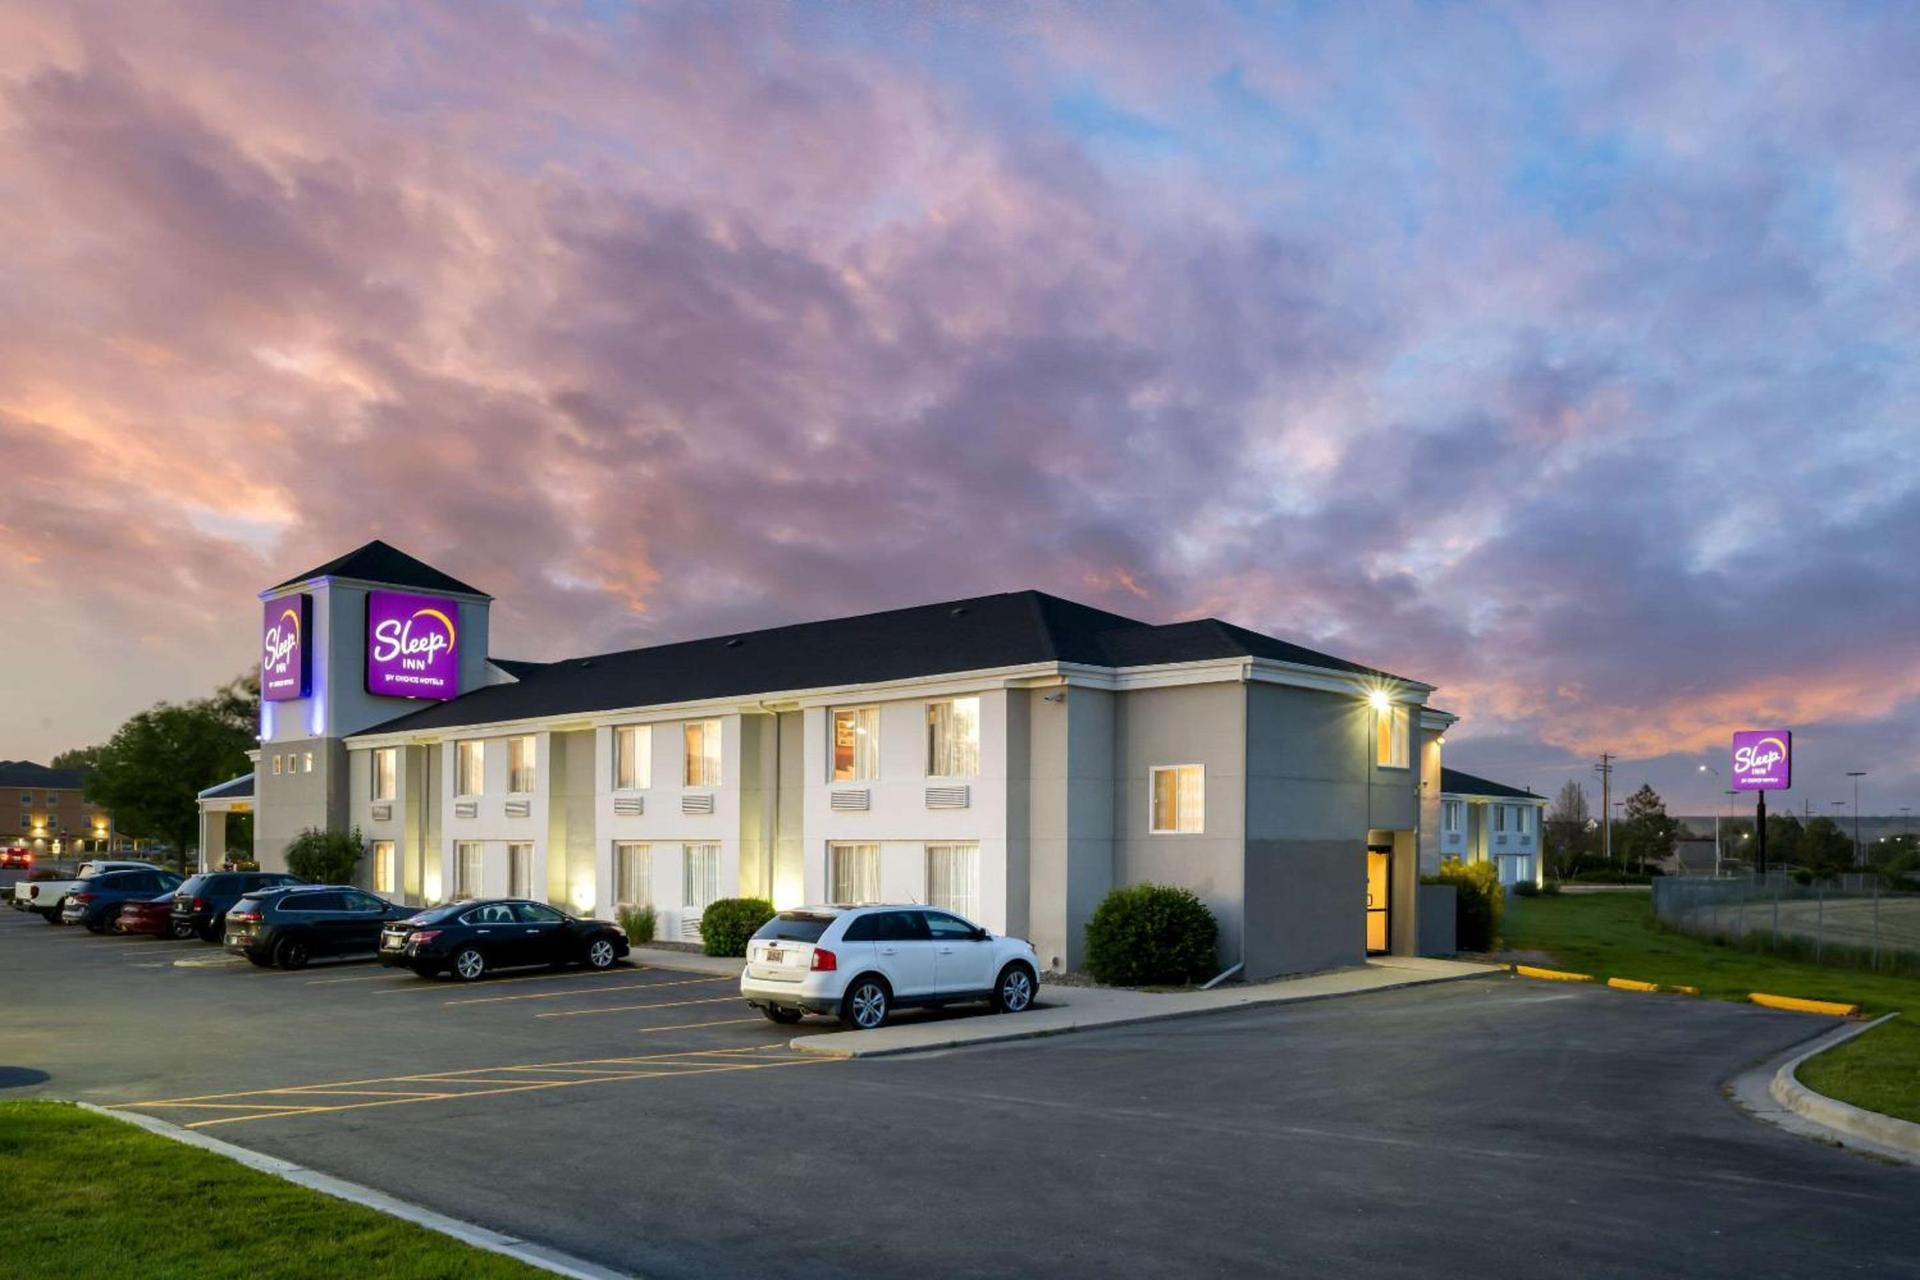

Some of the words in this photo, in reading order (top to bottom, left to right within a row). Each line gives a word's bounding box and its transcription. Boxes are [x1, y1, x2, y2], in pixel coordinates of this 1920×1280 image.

[264, 623, 295, 671] Sleep
[374, 619, 447, 665] Sleep
[275, 663, 287, 673] INN
[402, 659, 425, 671] INN
[1734, 745, 1781, 773] Sleep
